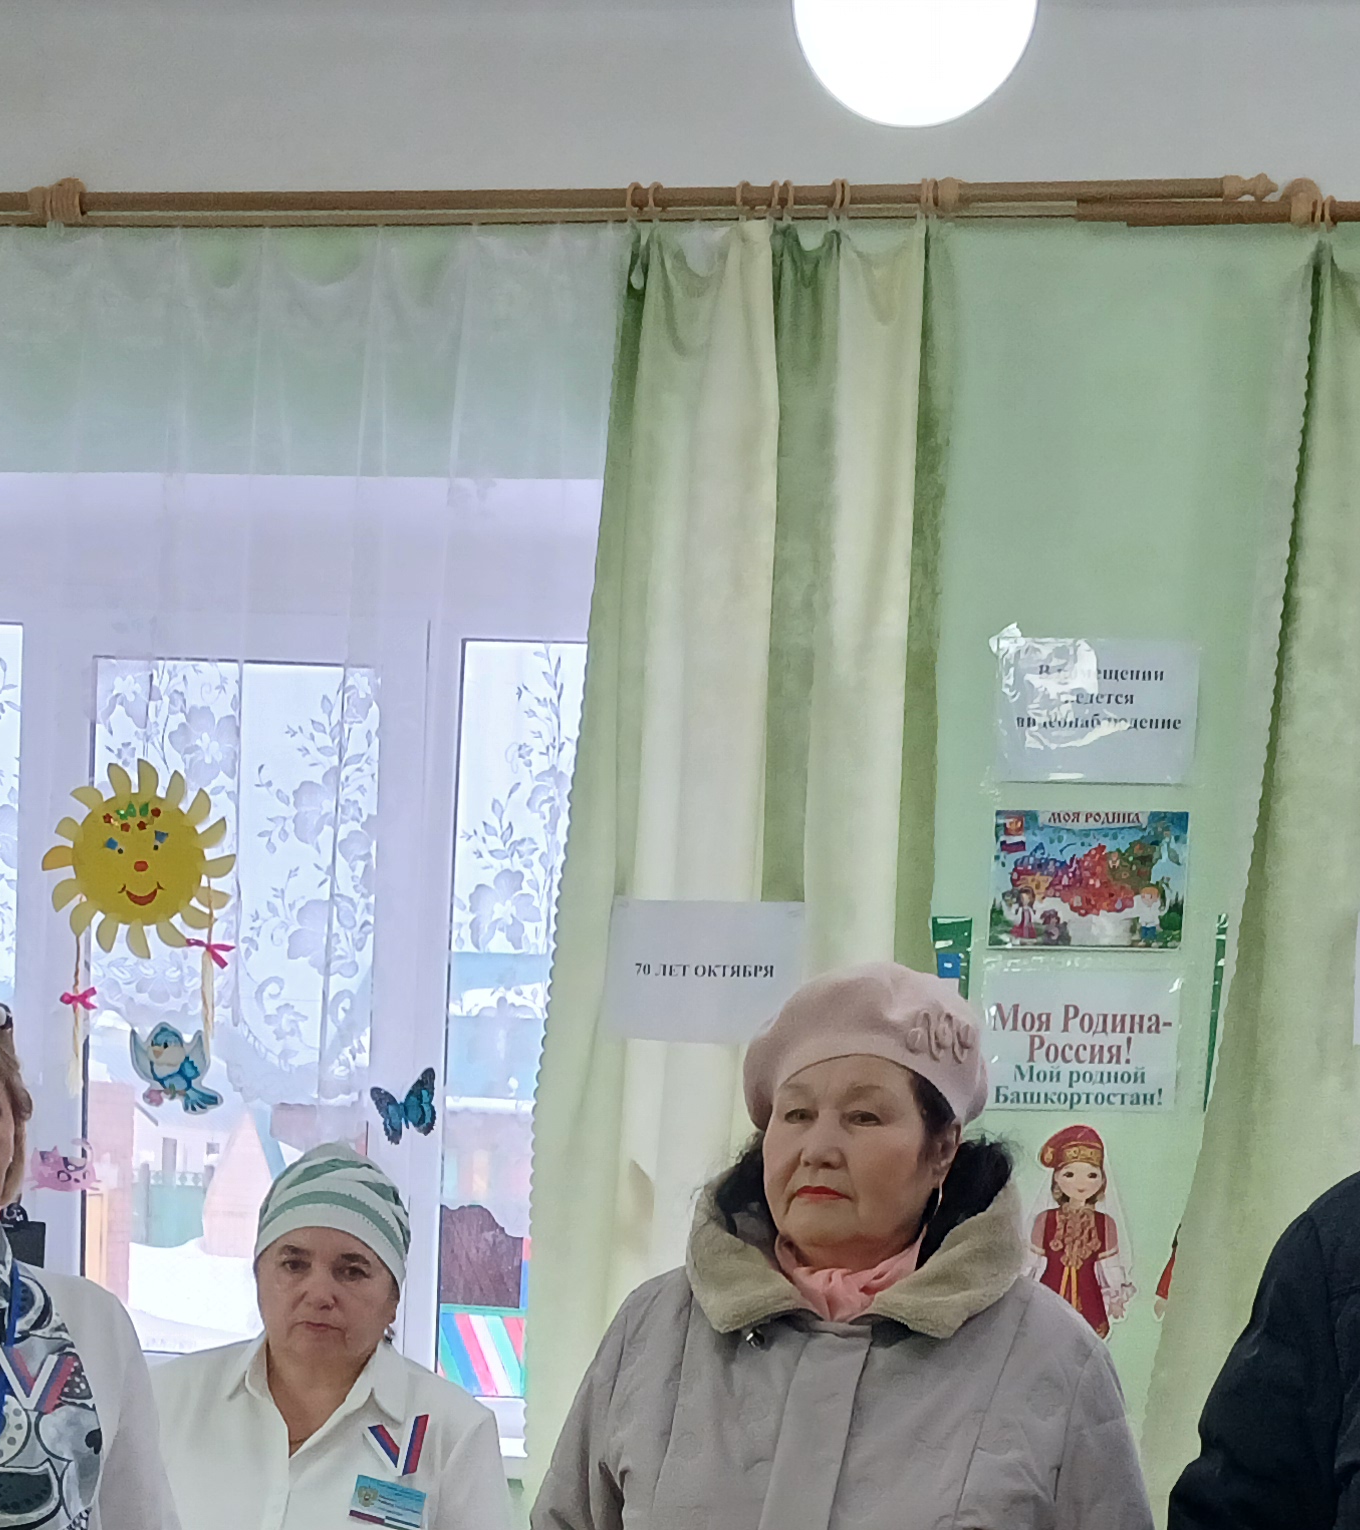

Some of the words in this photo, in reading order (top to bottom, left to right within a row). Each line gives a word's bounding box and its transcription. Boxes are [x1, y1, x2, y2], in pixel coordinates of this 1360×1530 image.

[1064, 693, 1135, 706] едется
[1048, 811, 1081, 824] МОЯ
[634, 962, 651, 977] 70
[654, 963, 690, 977] ЛЕТ
[693, 964, 775, 979] ОКТЯБРЯ
[992, 1002, 1052, 1033] Моя
[1060, 1003, 1173, 1037] Родина-
[1026, 1033, 1133, 1065] Россия!
[1013, 1064, 1061, 1085] Мой
[1068, 1066, 1146, 1088] родной
[993, 1085, 1163, 1110] Башкортостан!
